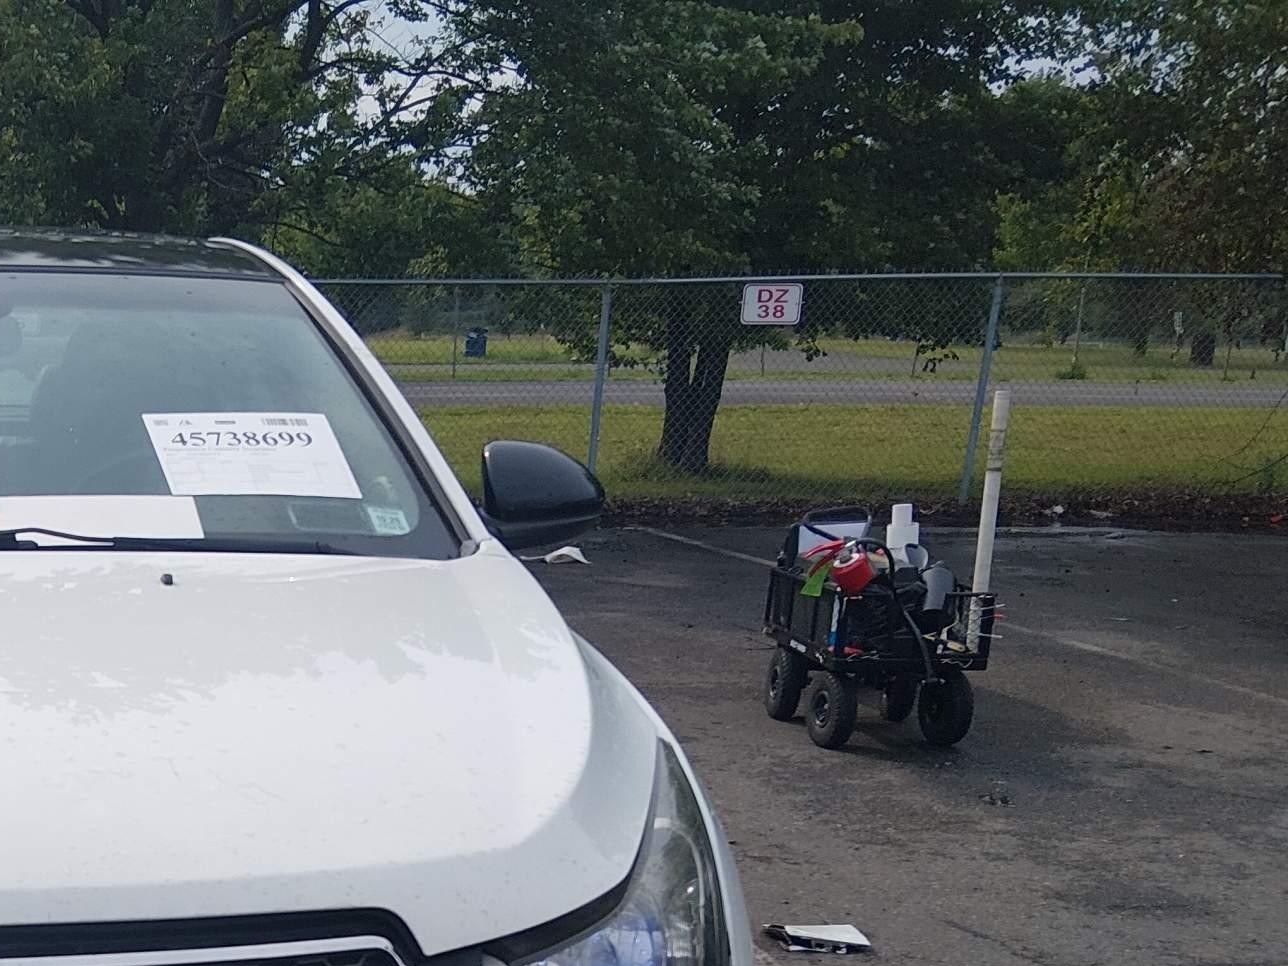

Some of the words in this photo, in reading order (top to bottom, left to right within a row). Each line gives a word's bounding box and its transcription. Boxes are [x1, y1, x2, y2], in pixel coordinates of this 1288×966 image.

[757, 288, 789, 303] DZ
[757, 304, 785, 319] 38
[170, 431, 313, 447] 45738699
